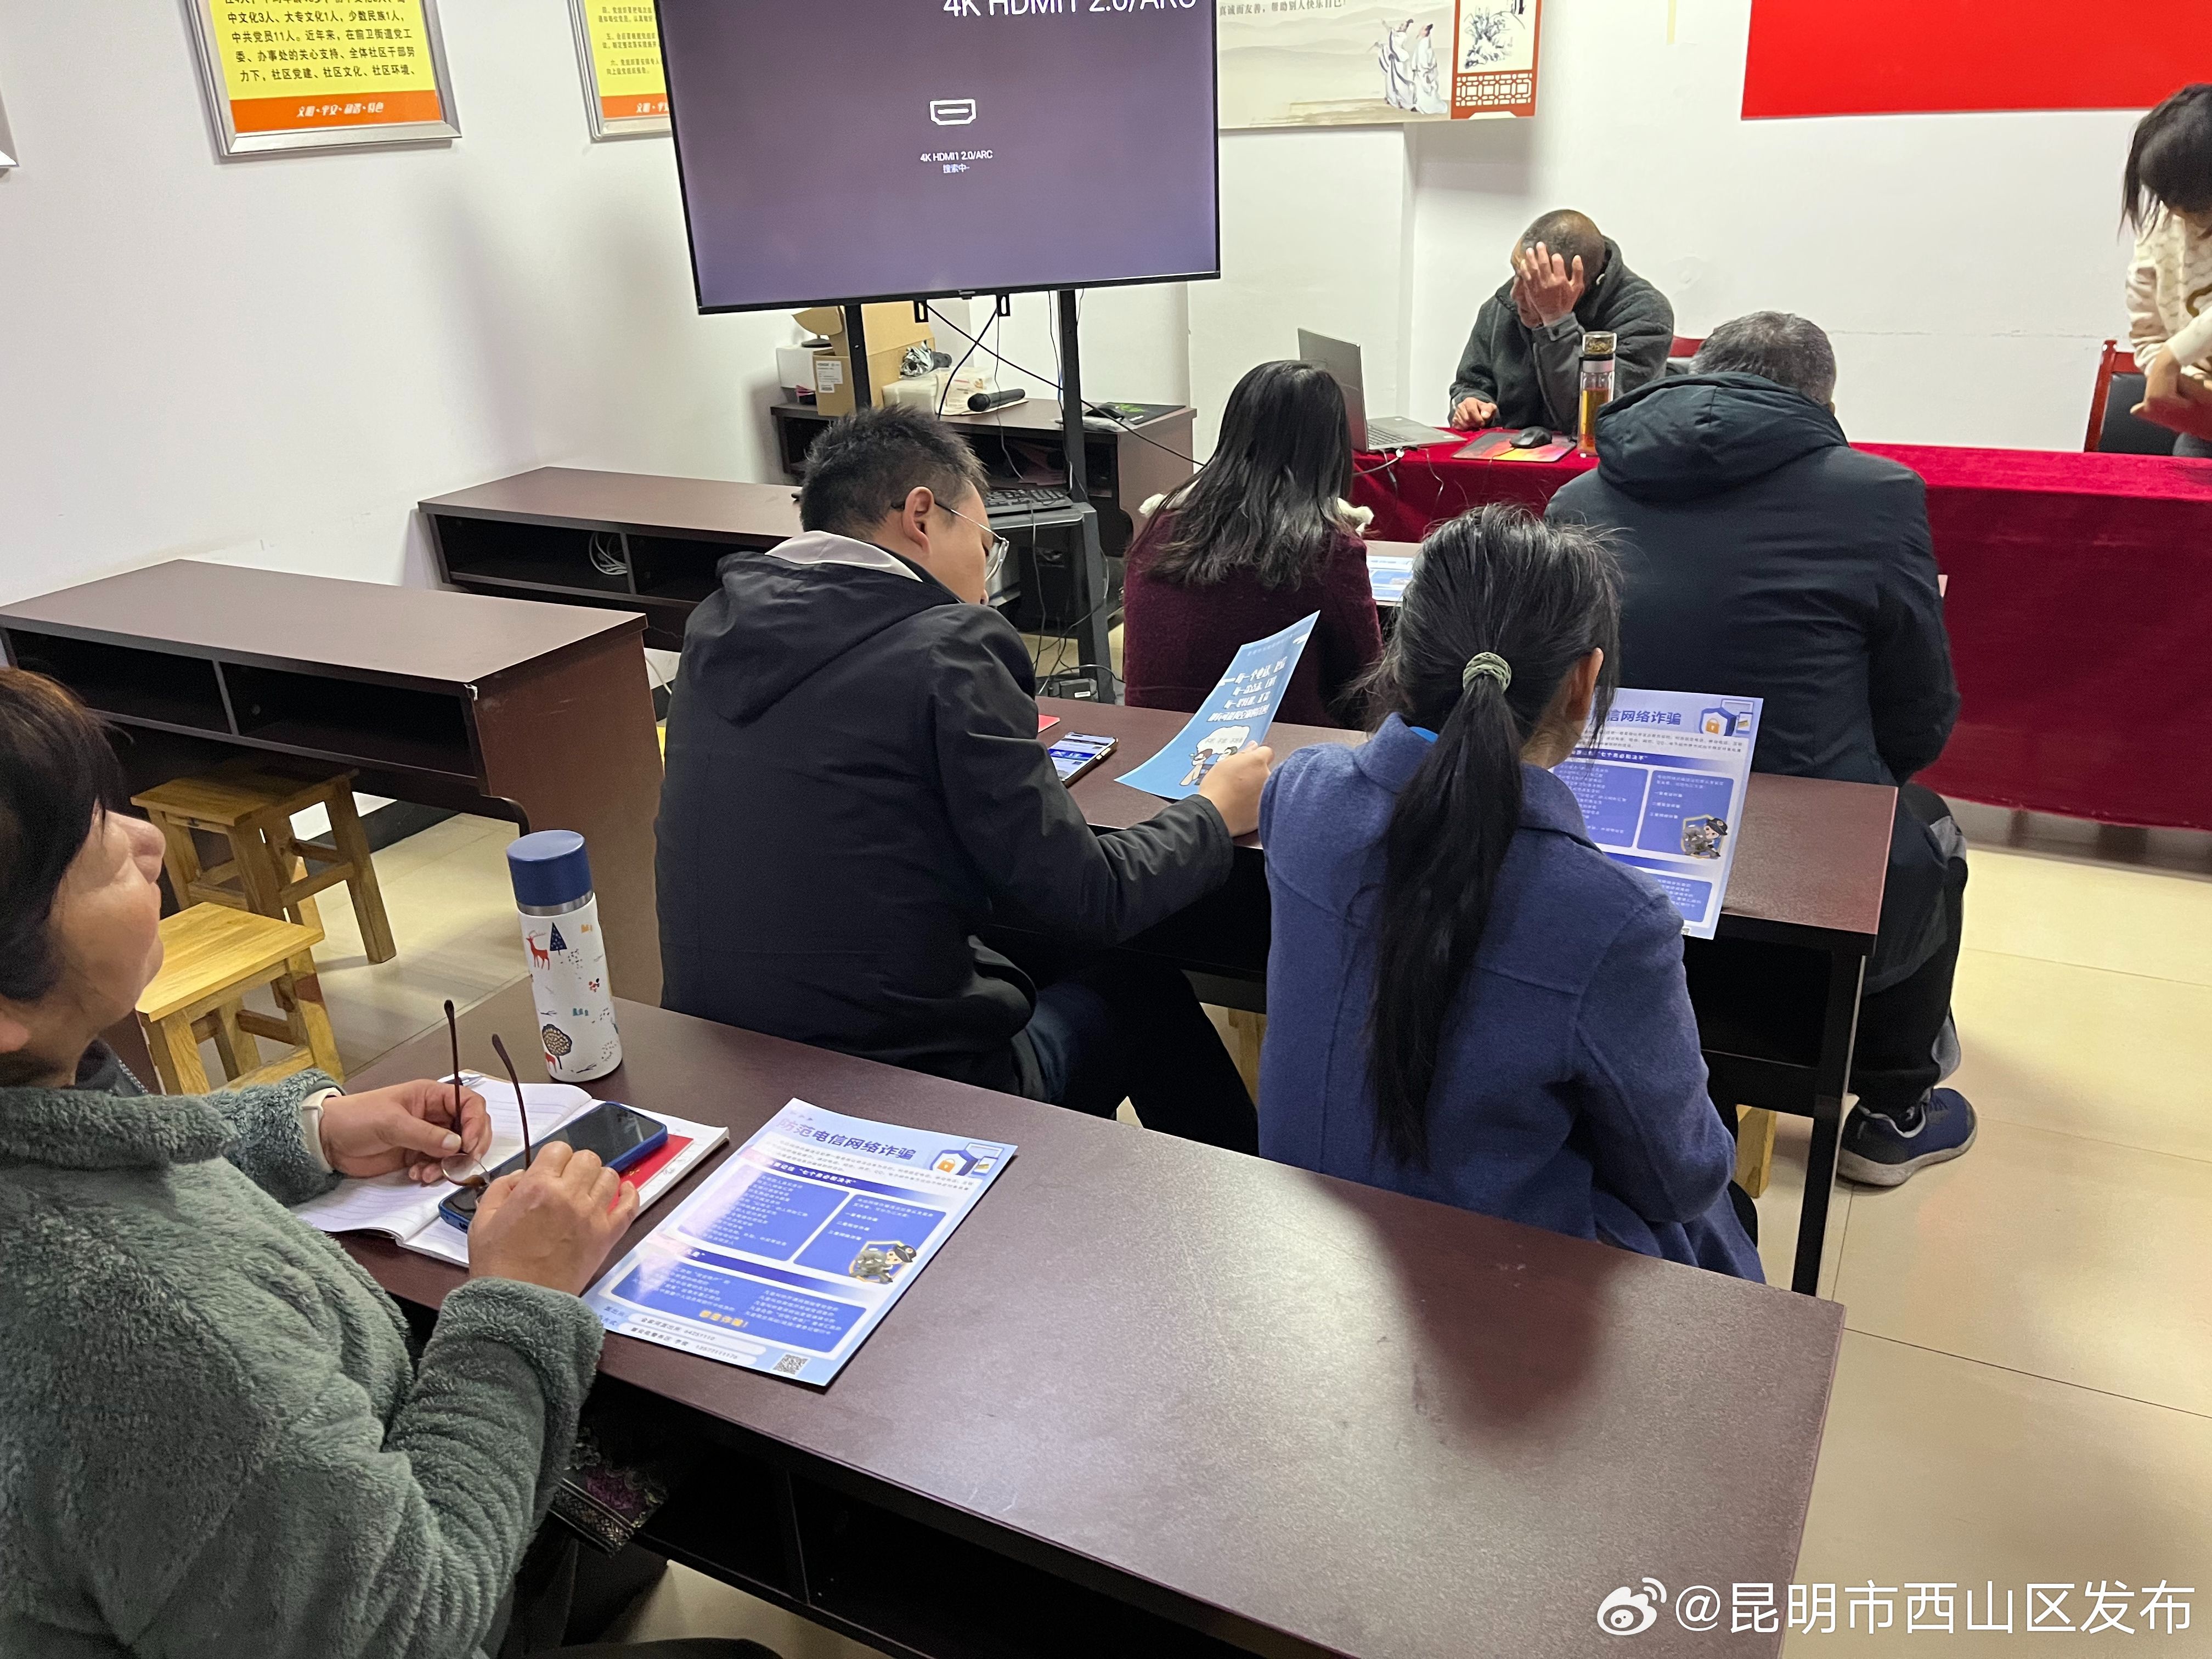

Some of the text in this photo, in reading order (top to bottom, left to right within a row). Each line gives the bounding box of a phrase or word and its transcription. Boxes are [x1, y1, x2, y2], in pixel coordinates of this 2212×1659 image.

[943, 0, 981, 17] 4K
[920, 153, 932, 162] 4K
[933, 151, 959, 161] HDMI1
[776, 1118, 917, 1160] 防范电信网络诈骗
